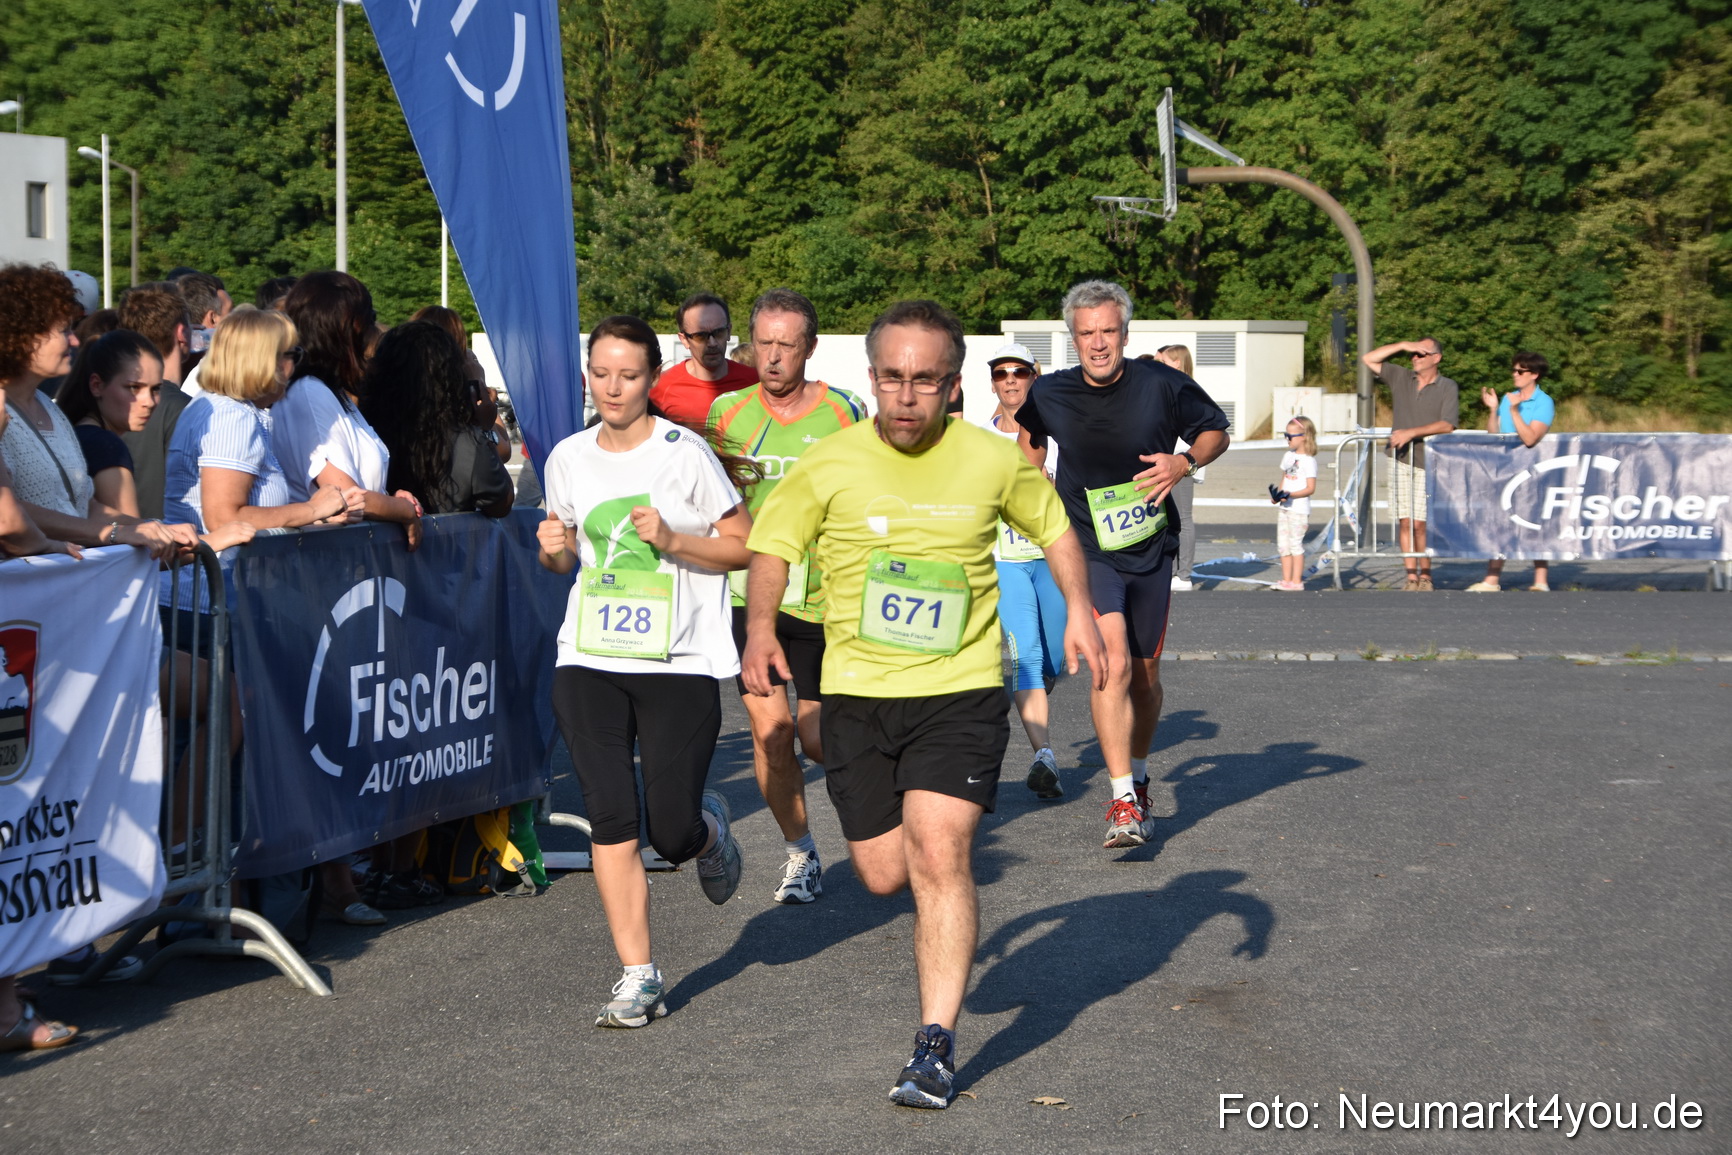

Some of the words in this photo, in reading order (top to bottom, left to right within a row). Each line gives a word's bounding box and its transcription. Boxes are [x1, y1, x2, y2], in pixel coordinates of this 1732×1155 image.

[1102, 498, 1160, 534] 1296
[1541, 486, 1731, 521] Fischer
[1558, 525, 1715, 541] AUTOMOBILE
[598, 603, 652, 634] 128
[881, 592, 943, 629] 671
[601, 636, 616, 644] Anna
[616, 637, 644, 646] Grzywacz
[884, 626, 910, 638] Thomas
[910, 631, 936, 641] Fischer
[358, 733, 494, 796] AUTOMOBILE
